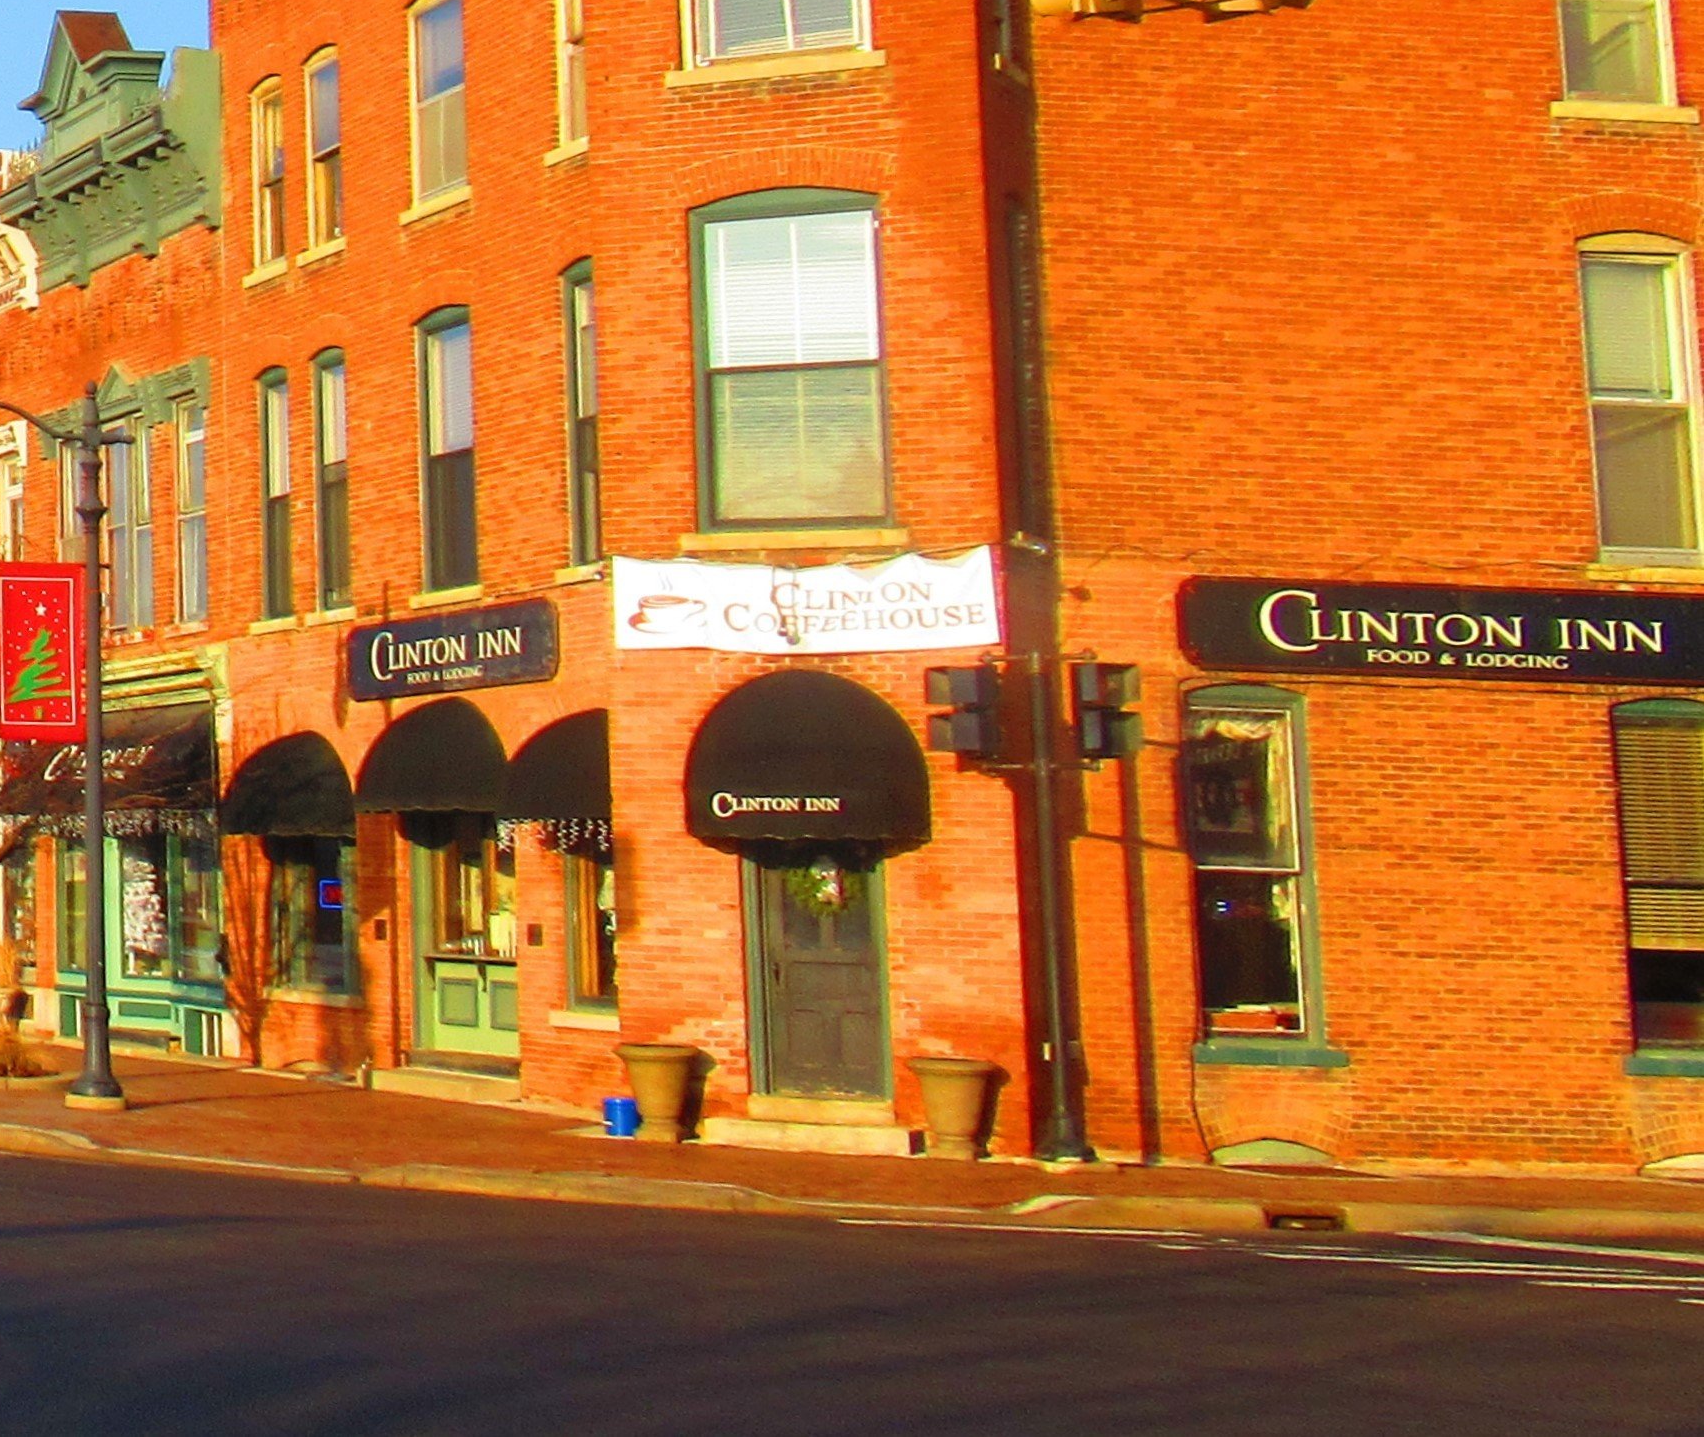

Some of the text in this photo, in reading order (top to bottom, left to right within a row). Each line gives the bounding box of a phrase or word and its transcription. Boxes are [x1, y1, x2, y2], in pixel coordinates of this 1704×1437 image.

[1259, 589, 1664, 654] CLINTON INN
[371, 626, 522, 681] CLINTON INN
[1366, 648, 1570, 670] FOOD & LODGING
[712, 792, 840, 818] CLINTON INN
